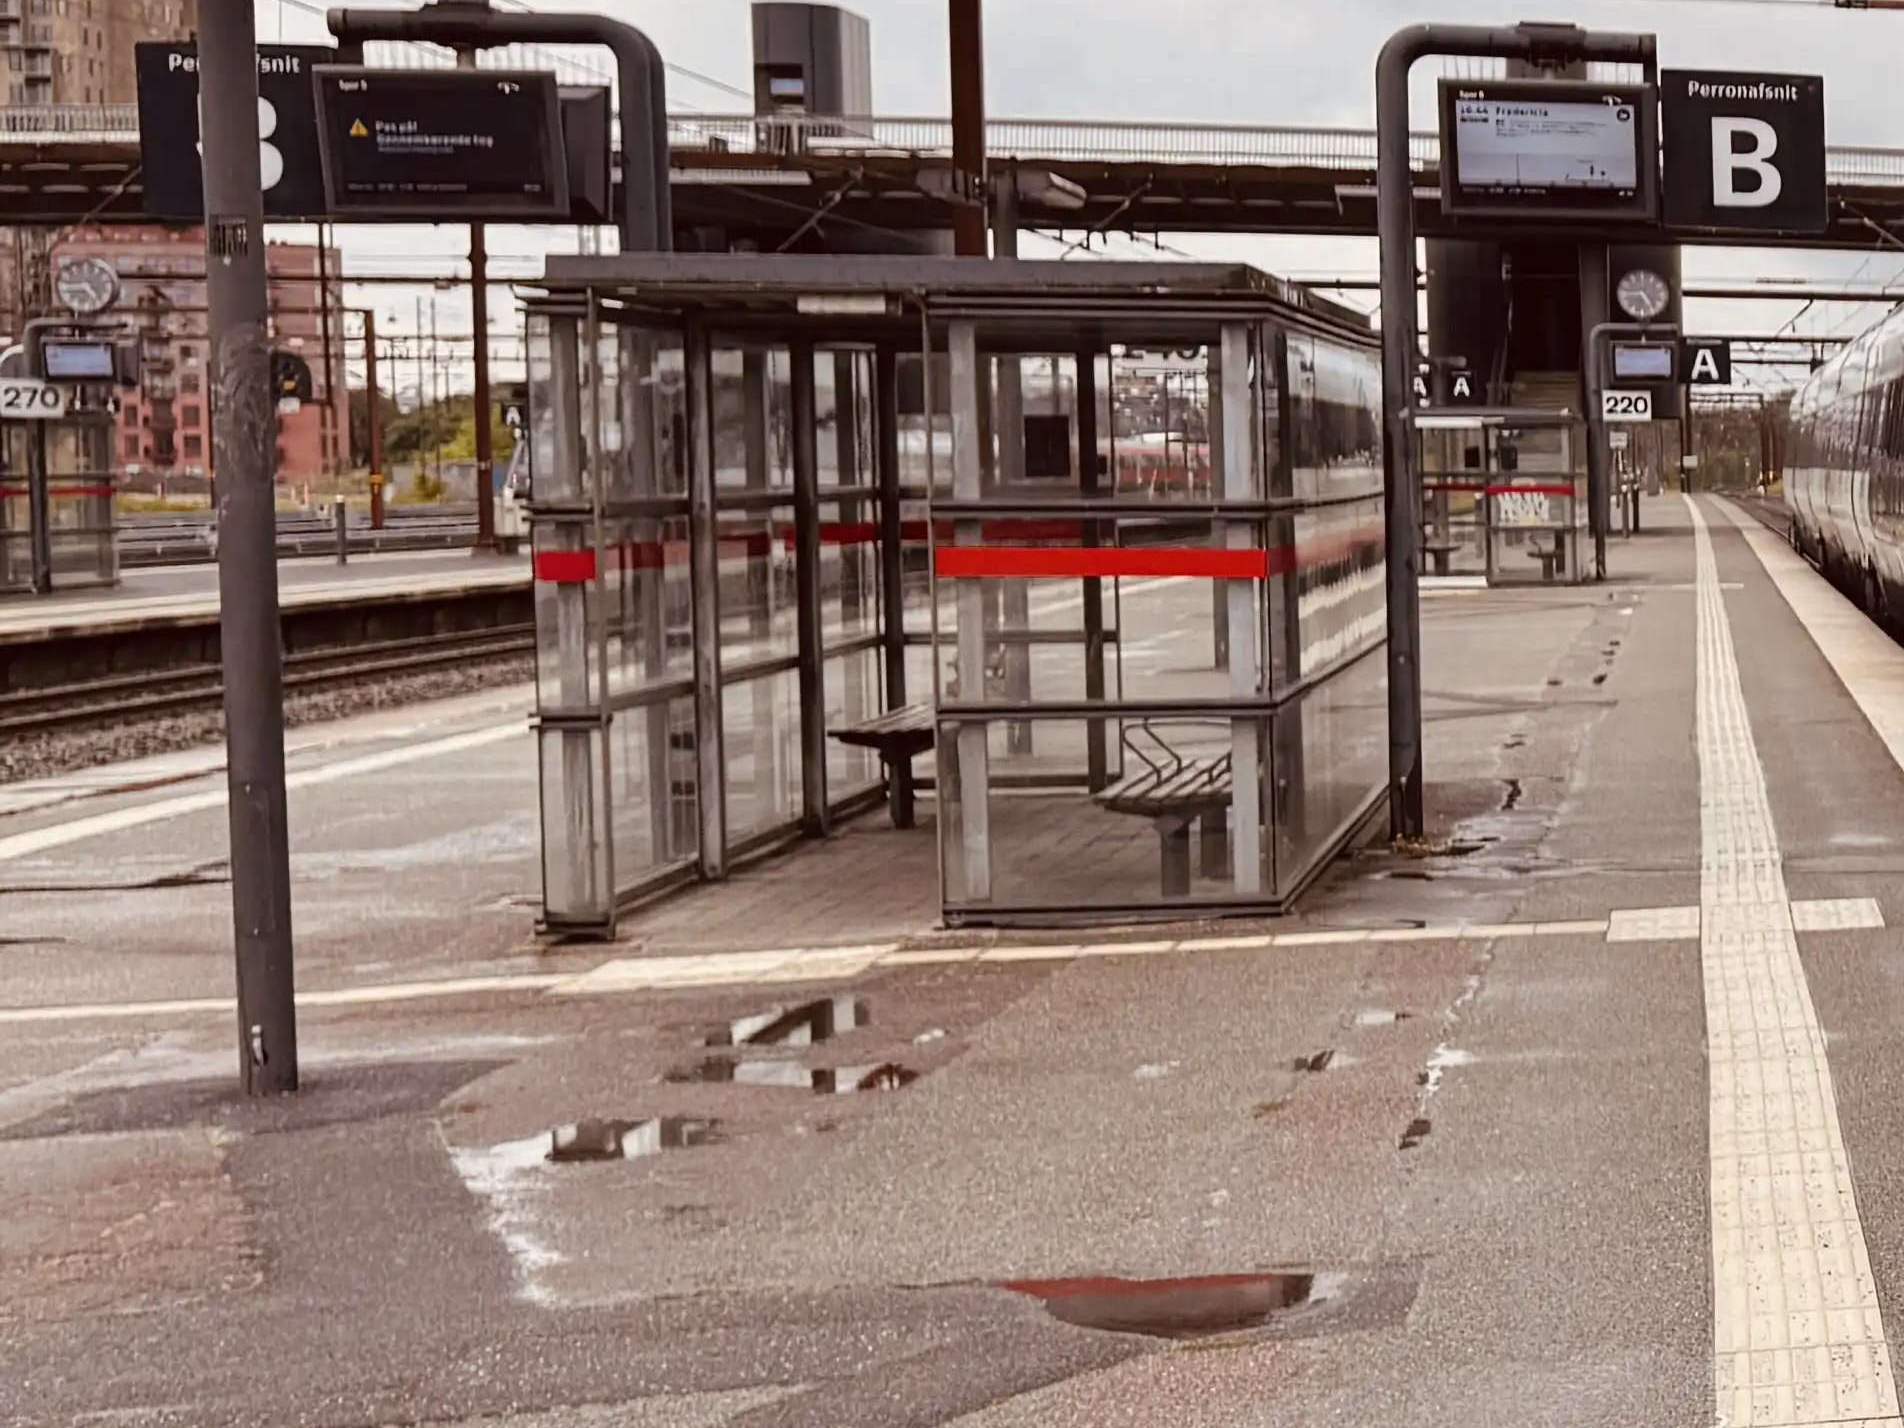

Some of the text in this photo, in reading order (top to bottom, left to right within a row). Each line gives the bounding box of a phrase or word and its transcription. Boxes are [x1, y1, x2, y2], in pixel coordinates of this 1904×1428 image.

[169, 53, 300, 73] Pesnit
[1688, 80, 1799, 102] Perronafsnit
[1711, 116, 1782, 208] B
[1691, 348, 1720, 381] A
[3, 385, 60, 410] 270
[1453, 376, 1470, 397] A
[1606, 396, 1648, 414] 220
